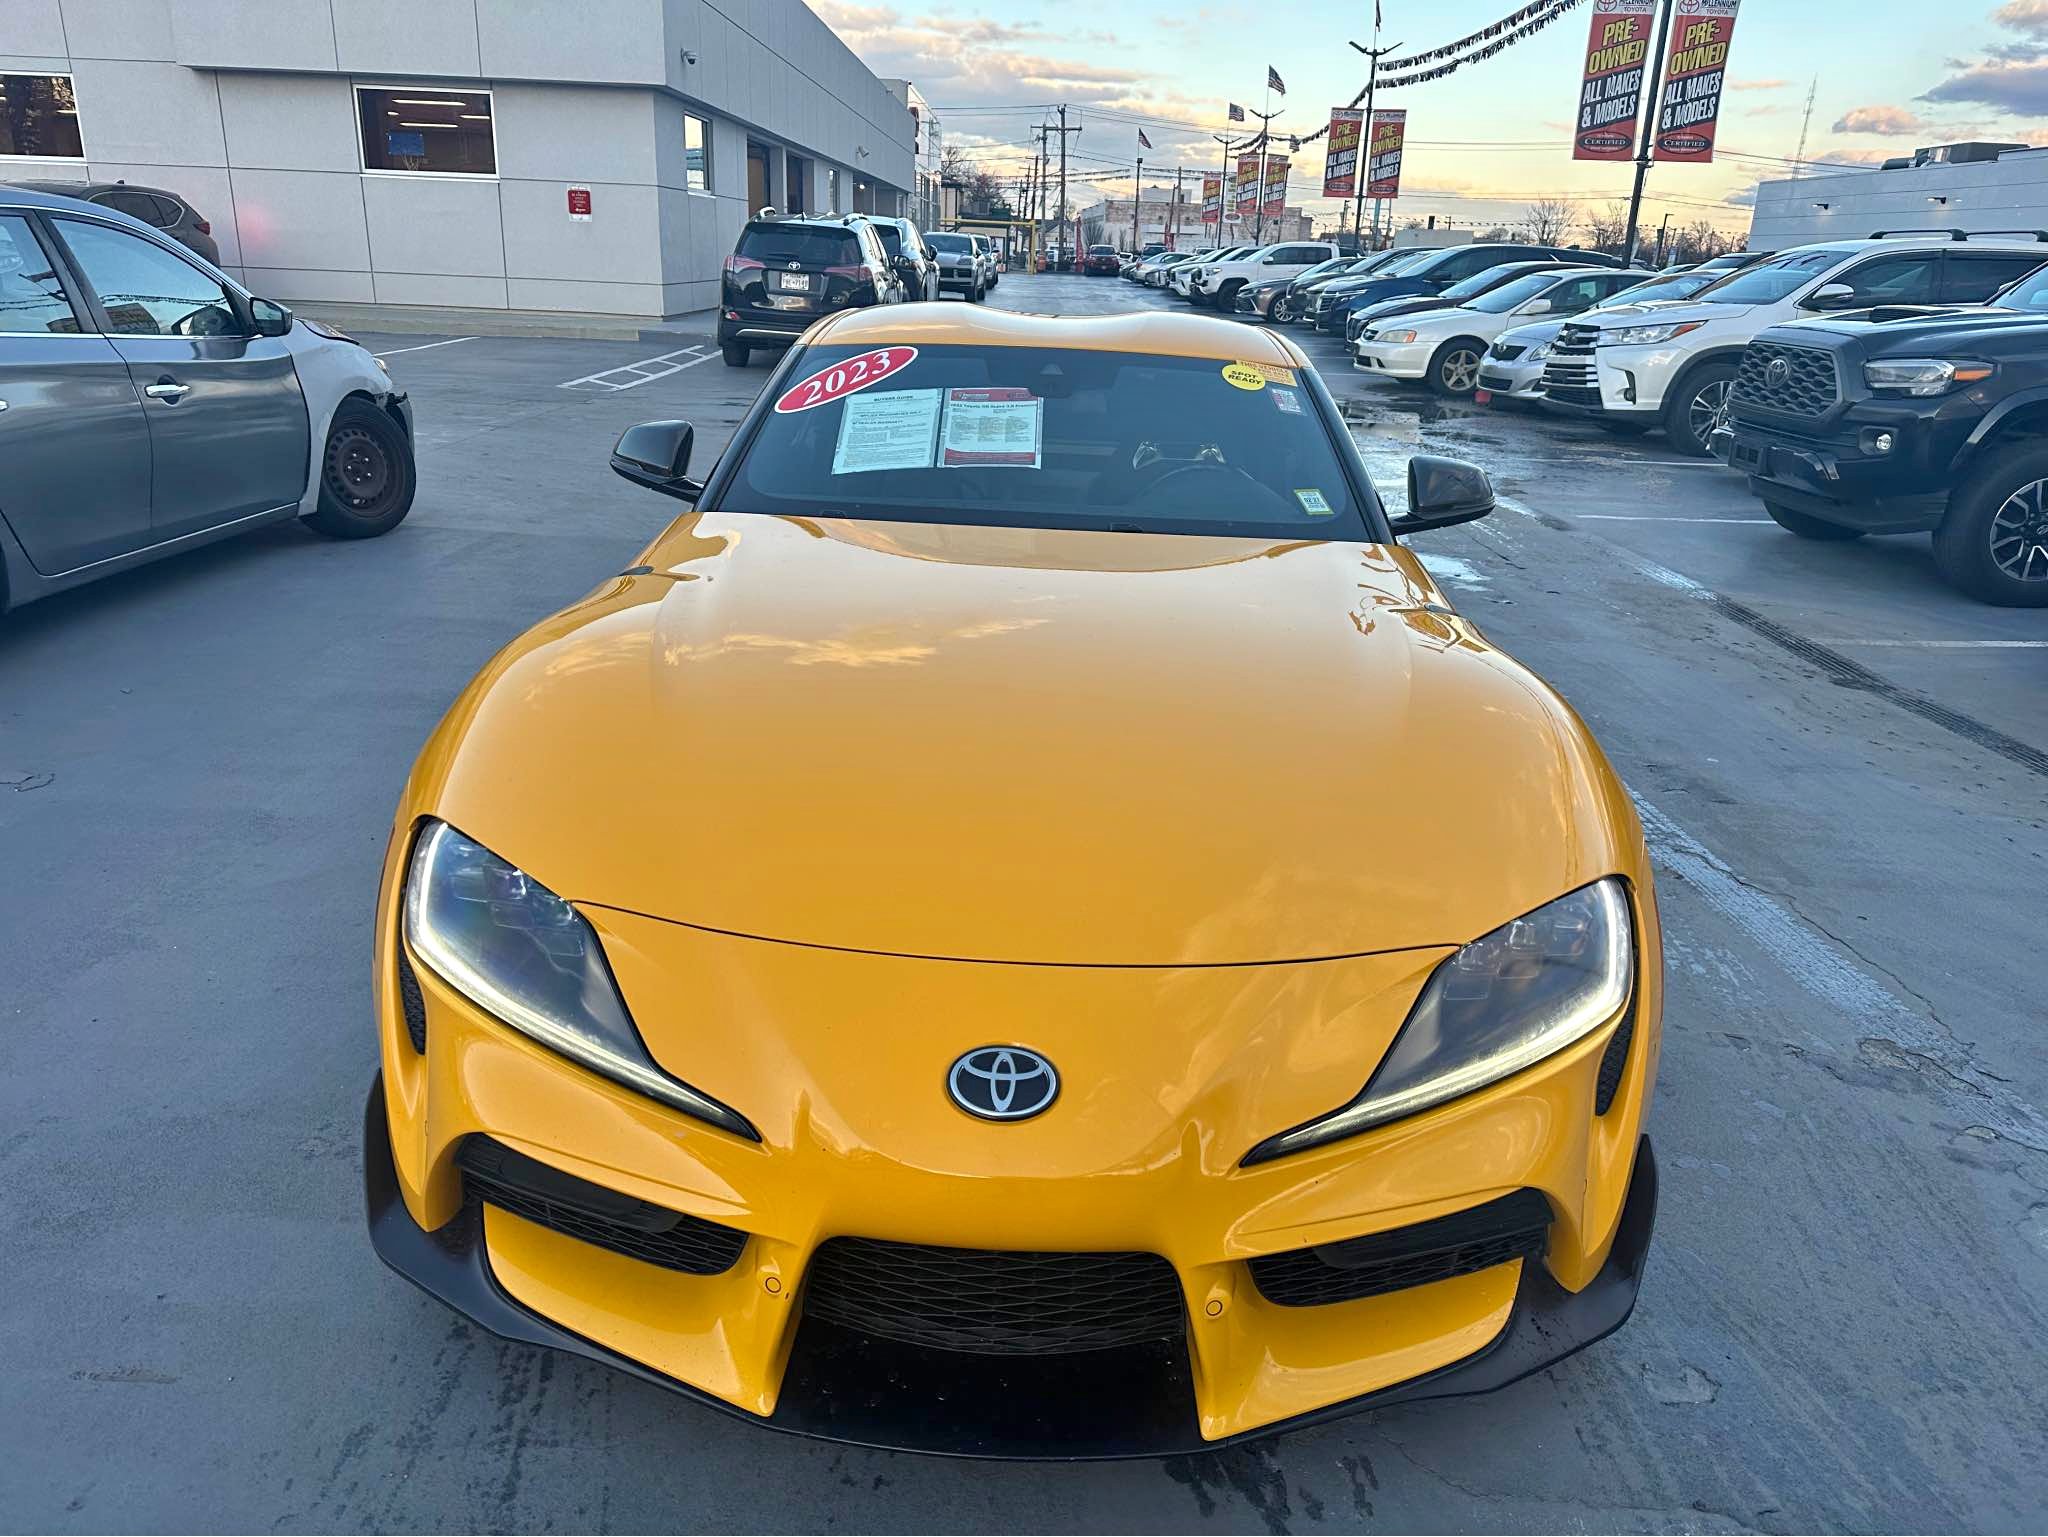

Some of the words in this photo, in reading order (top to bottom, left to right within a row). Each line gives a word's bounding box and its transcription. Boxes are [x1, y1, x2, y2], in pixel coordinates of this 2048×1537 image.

[1602, 17, 1639, 47] PRE-
[1684, 19, 1721, 48] PRE-
[1588, 39, 1647, 75] OWNED
[1670, 41, 1727, 76] OWNED
[1582, 80, 1602, 105] ALL
[1605, 69, 1642, 97] MAKES
[1663, 81, 1683, 106] ALL
[1686, 71, 1722, 99] MAKES
[1581, 108, 1592, 128] &
[1593, 95, 1637, 125] MODELS
[1661, 108, 1672, 129] &
[1673, 96, 1716, 126] MODELS
[1336, 122, 1354, 136] PRE-
[1379, 124, 1397, 138] PRE-
[1330, 134, 1358, 150] OWNED
[1372, 135, 1401, 153] OWNED
[1664, 139, 1705, 147] CERTIFIED
[1328, 153, 1337, 166] ALL
[1338, 149, 1357, 163] MAKES
[1370, 156, 1380, 169] ALL
[1381, 151, 1401, 166] MAKES
[1333, 162, 1355, 177] MODELS
[1376, 164, 1399, 180] MODELS
[803, 351, 891, 406] 2023
[1227, 374, 1262, 385] READY
[1231, 370, 1258, 379] SPOT
